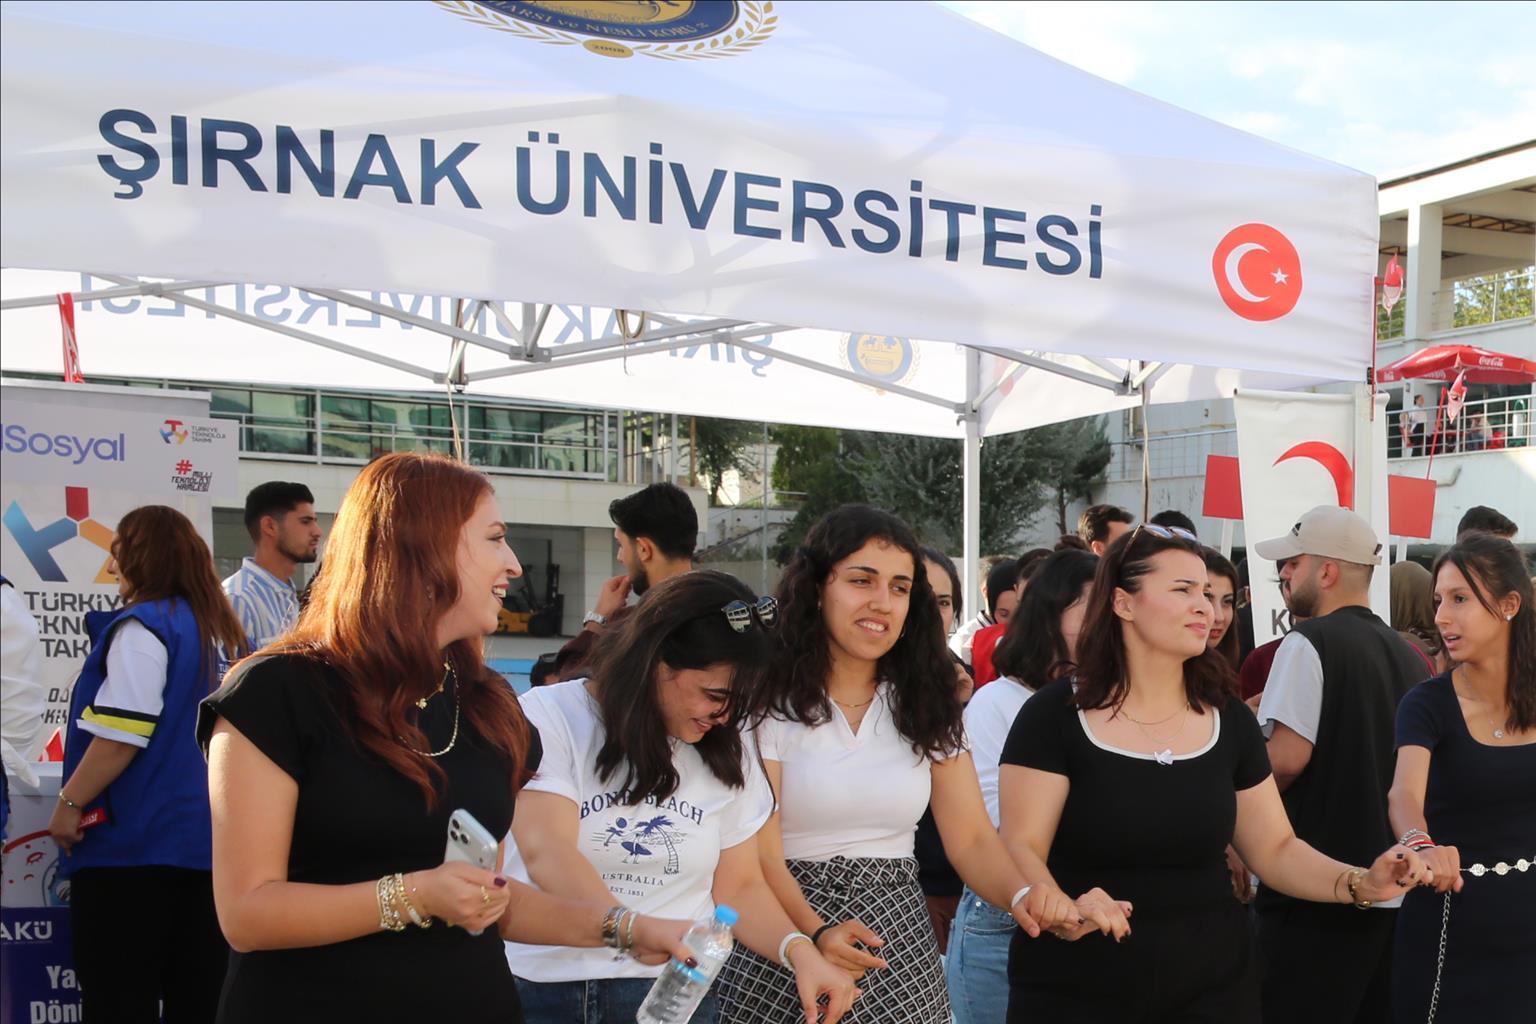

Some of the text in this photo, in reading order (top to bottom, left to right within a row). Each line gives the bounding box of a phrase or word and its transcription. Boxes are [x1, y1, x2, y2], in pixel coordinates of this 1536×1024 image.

[97, 108, 1103, 280] ŞIRNAK ÜNİVERSİTESİ
[0, 424, 125, 465] Sosyal
[24, 591, 120, 612] TÜRKİY
[40, 638, 91, 658] TAK
[602, 873, 664, 887] USTRALIA
